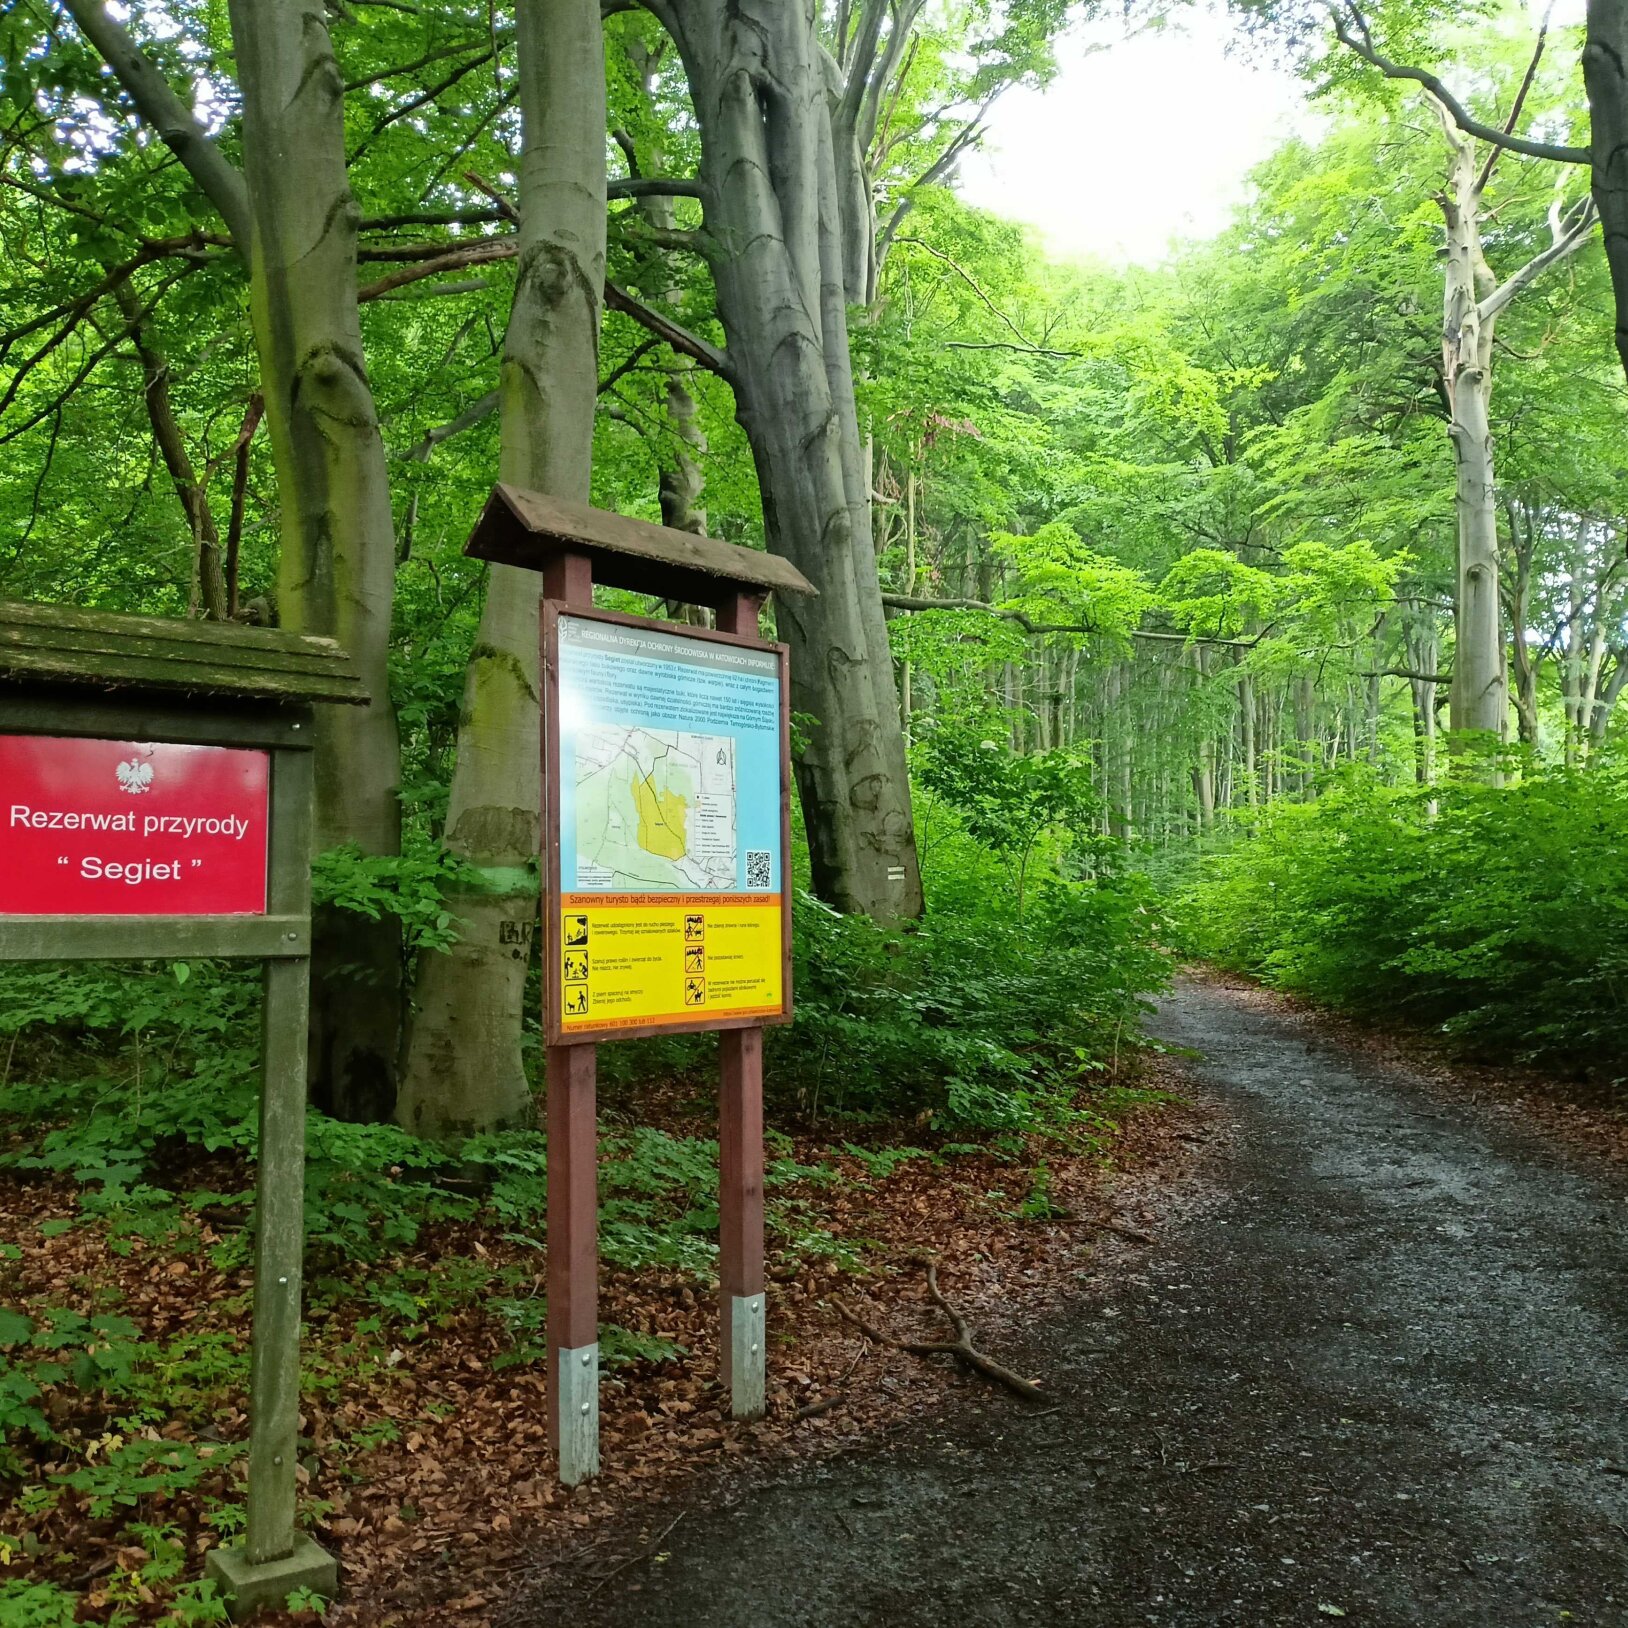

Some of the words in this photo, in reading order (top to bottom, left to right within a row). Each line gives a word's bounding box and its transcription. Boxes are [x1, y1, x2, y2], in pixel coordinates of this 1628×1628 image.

[581, 631, 618, 643] REGIONALNA
[619, 637, 647, 648] DYREKCJA
[647, 642, 674, 652] OCHRONY
[674, 645, 709, 658] ŚRODOWISKA
[709, 652, 716, 660] W
[716, 653, 748, 665] KATOWICACH
[10, 805, 136, 832] Rezerwat
[143, 814, 249, 840] przyrody
[80, 856, 181, 885] Segiet
[570, 895, 605, 904] Szanowny
[605, 895, 629, 905] turysto
[630, 893, 645, 904] bądź
[648, 894, 680, 904] bezpieczny
[686, 895, 721, 904] przestrzegaj
[723, 894, 752, 904] poniższych
